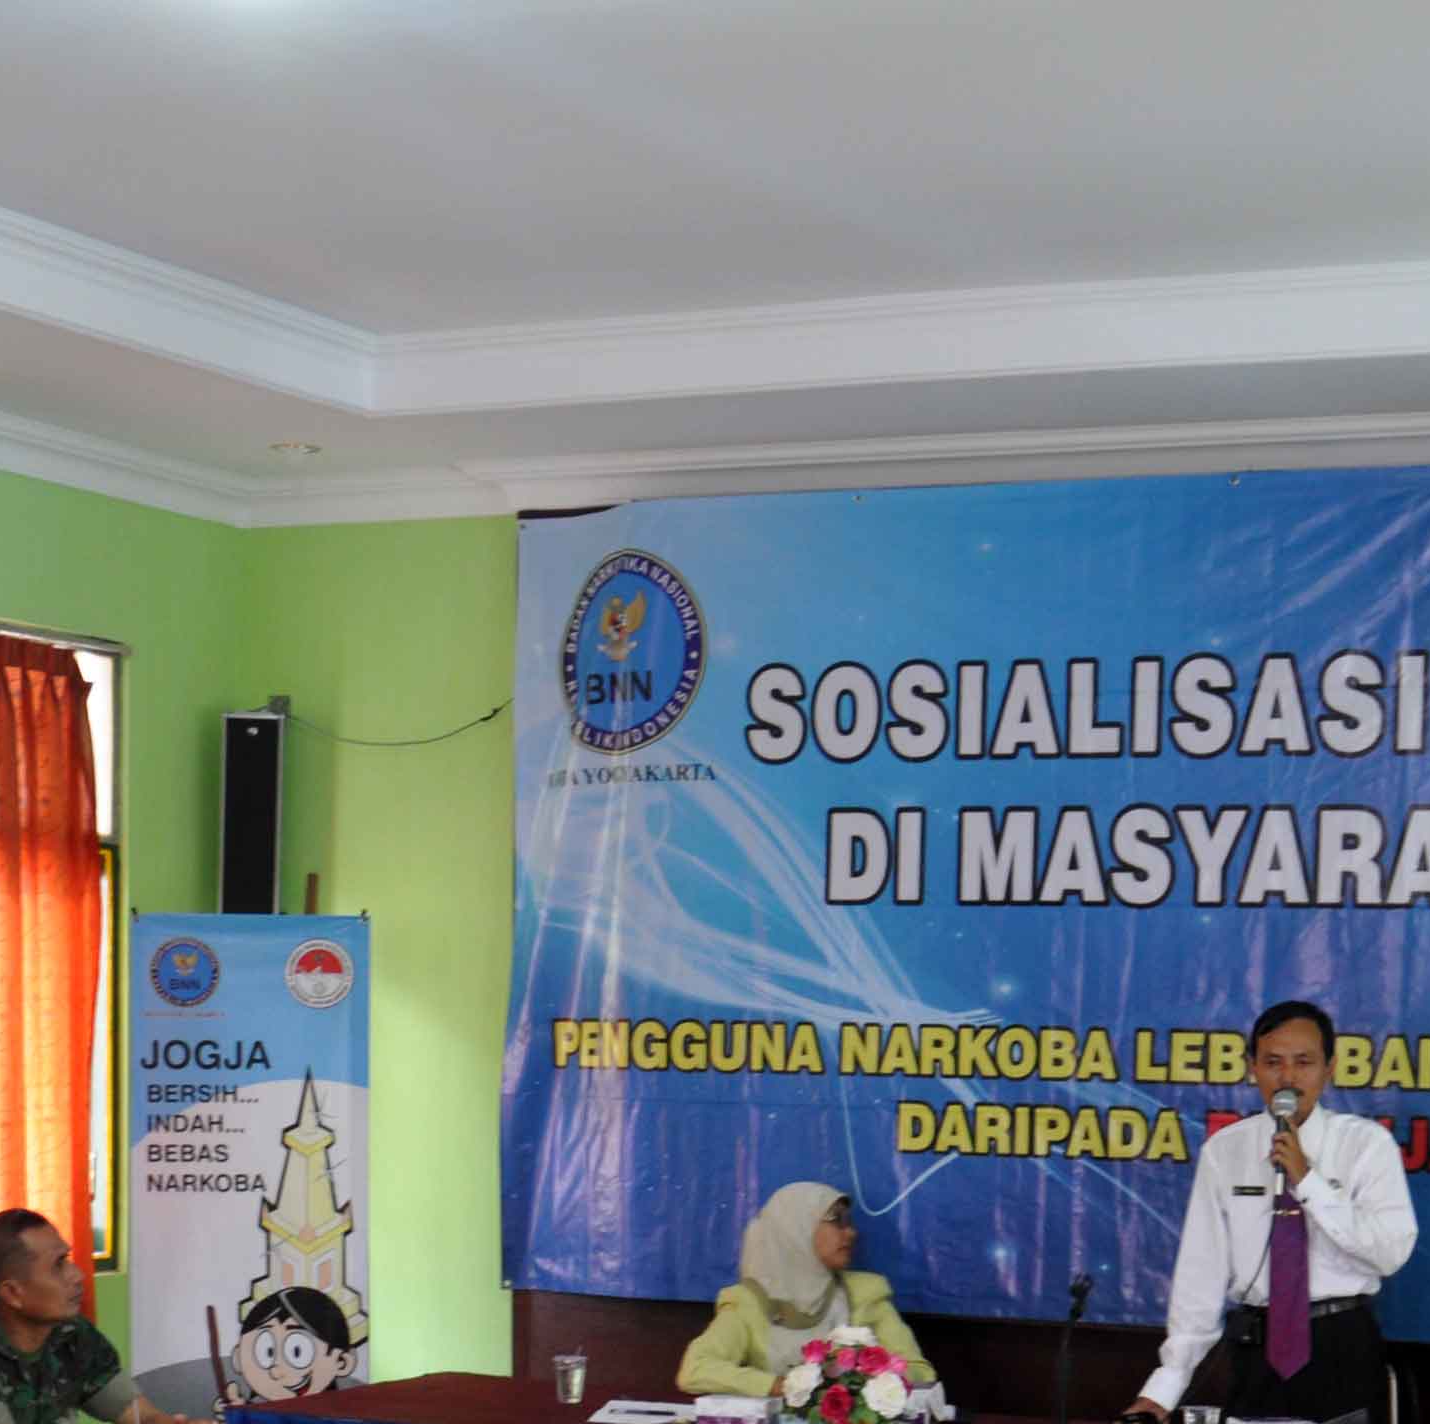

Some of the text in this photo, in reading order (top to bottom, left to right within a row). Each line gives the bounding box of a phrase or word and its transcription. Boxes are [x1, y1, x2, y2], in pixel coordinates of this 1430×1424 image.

[650, 563, 701, 640] NASIONAL
[586, 670, 653, 705] BNN
[823, 805, 927, 908] DI
[140, 1039, 271, 1070] JOGJA
[552, 1018, 825, 1075] PENGGUNA
[840, 1021, 1119, 1084] NARKOBA
[1134, 1029, 1259, 1085] LEB
[146, 1084, 259, 1104] BERSIH...
[146, 1114, 245, 1134] INDAH...
[895, 1101, 1190, 1161] DARIPADA
[146, 1144, 229, 1163] BEBAS
[145, 1173, 269, 1193] NARKOBA
